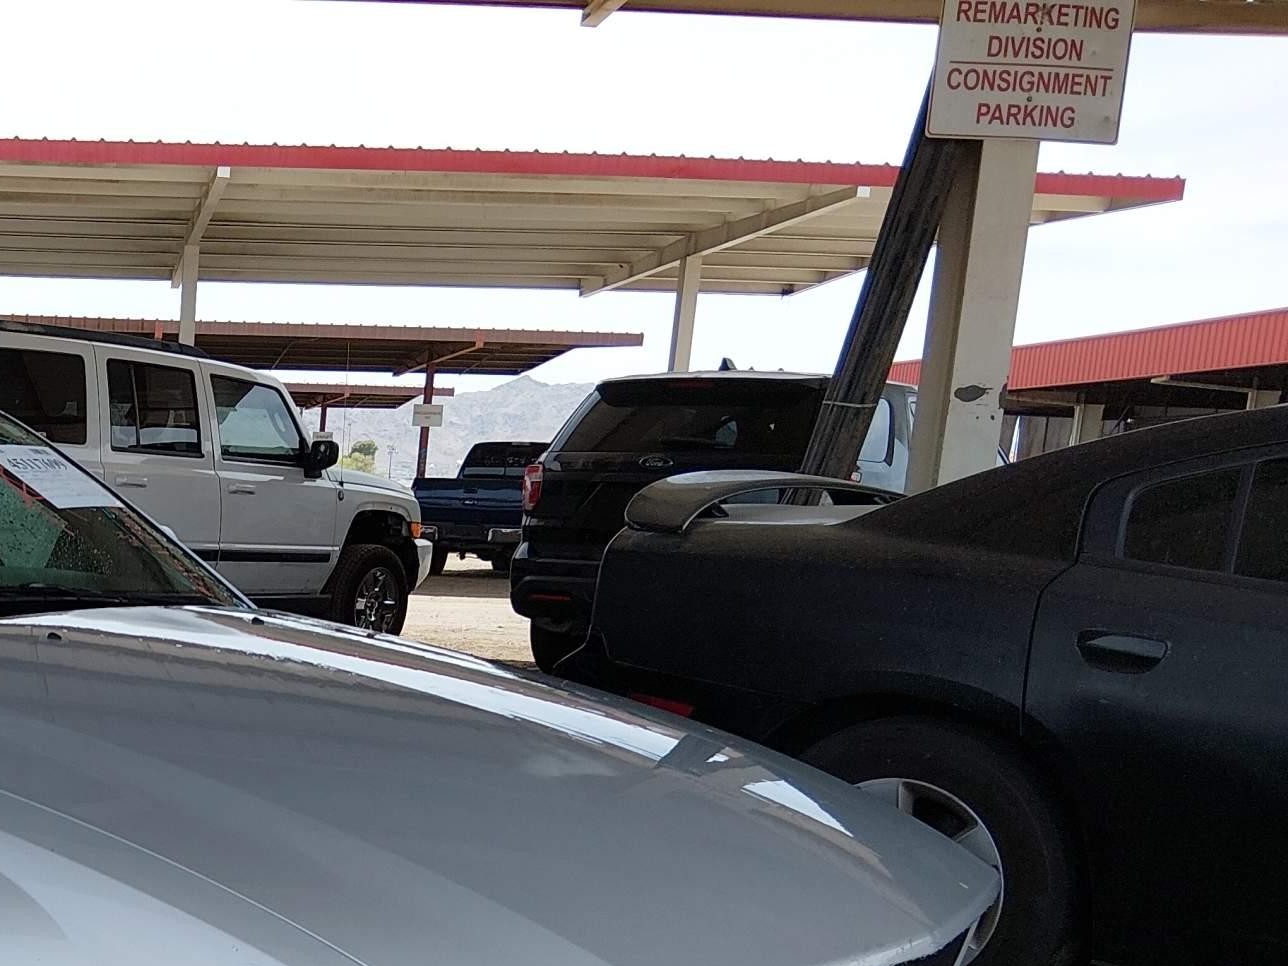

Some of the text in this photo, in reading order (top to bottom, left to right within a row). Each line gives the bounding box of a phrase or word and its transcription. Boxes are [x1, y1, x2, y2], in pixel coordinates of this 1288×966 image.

[956, 1, 1120, 30] REMARKETING
[986, 35, 1084, 61] DIVISION
[946, 67, 1113, 97] CONSIGNMENT
[975, 102, 1076, 129] PARKING
